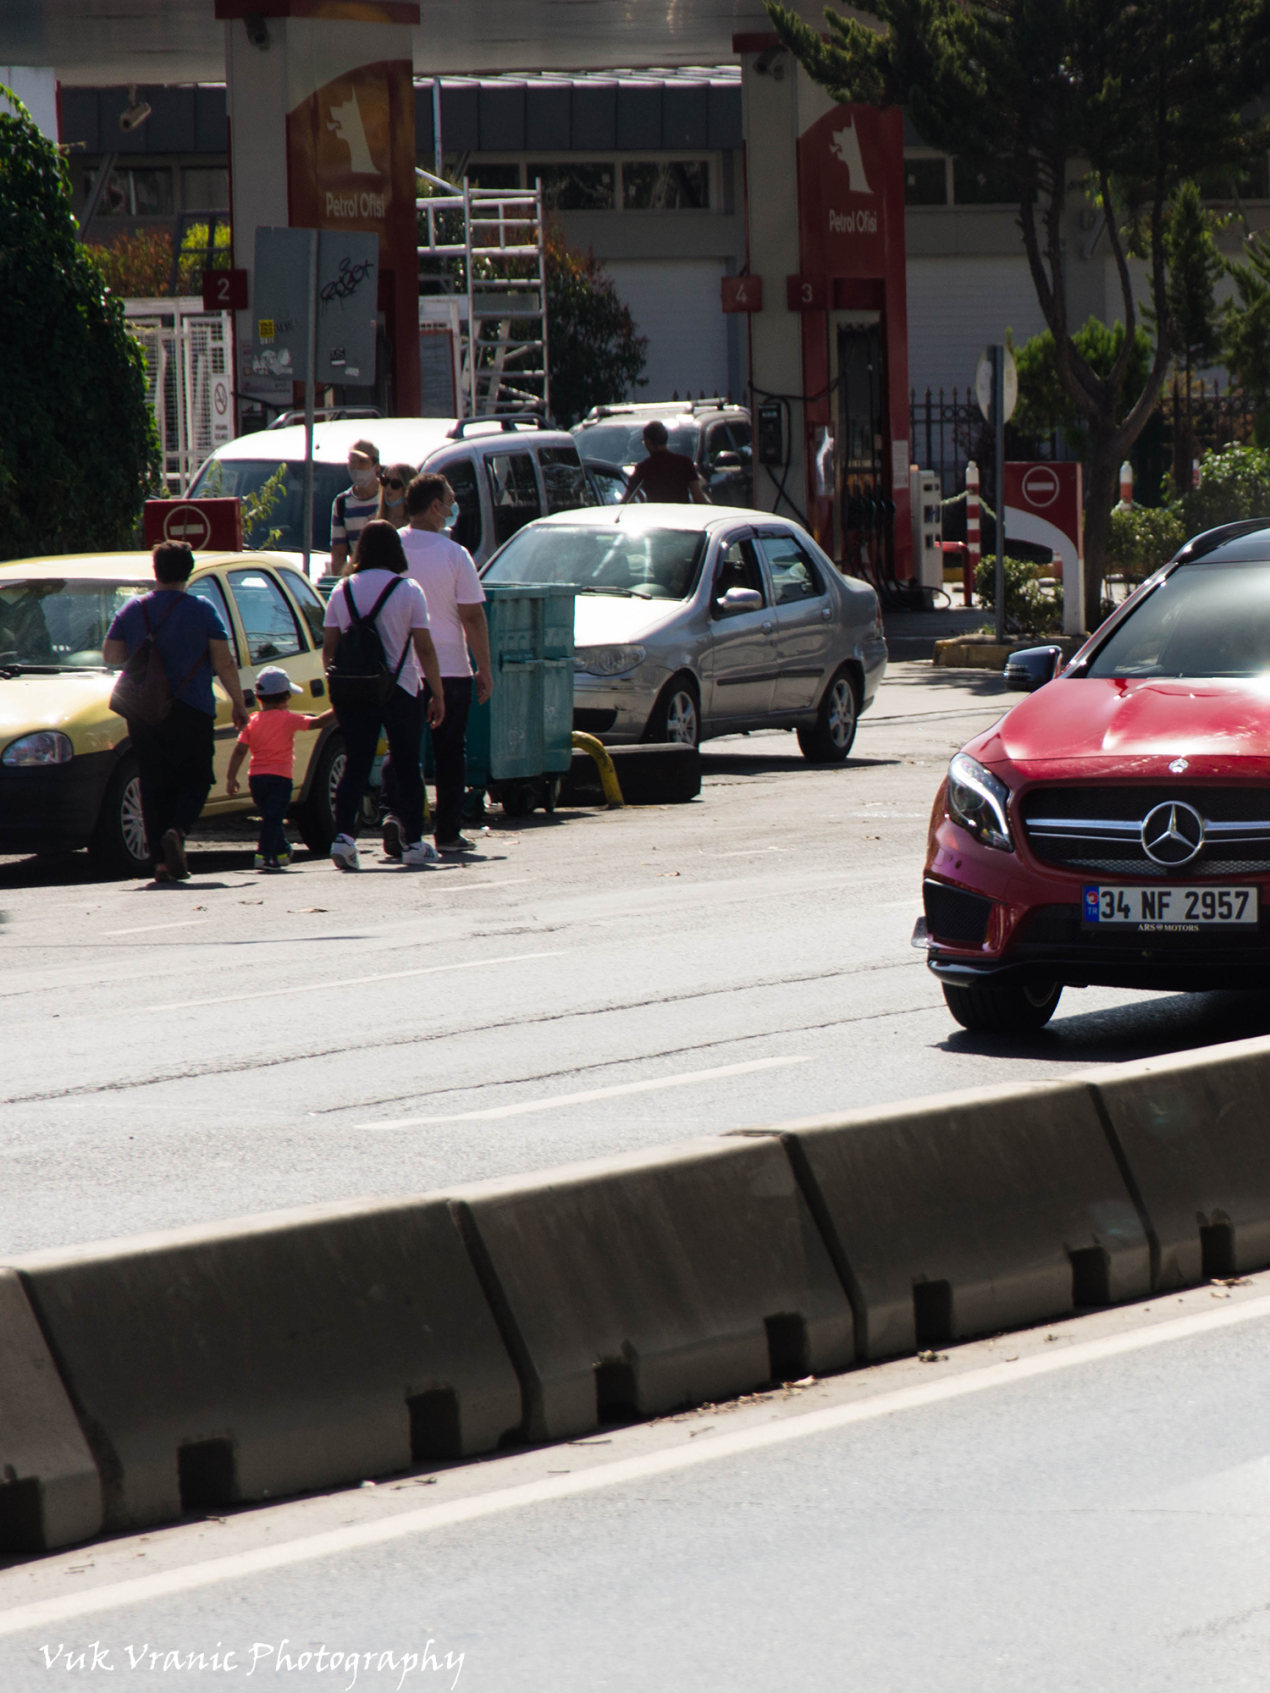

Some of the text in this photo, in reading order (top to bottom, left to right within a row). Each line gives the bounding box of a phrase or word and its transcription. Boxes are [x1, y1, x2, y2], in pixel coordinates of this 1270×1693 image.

[325, 191, 385, 218] Petrol Ofisi
[829, 208, 878, 233] Petrol Ofisi
[217, 278, 230, 301] 2
[735, 283, 748, 303] 4
[801, 282, 813, 303] 3
[1087, 907, 1098, 916] TR
[1100, 890, 1249, 920] 34 NF 2957
[1137, 923, 1199, 932] ARS MOTORS
